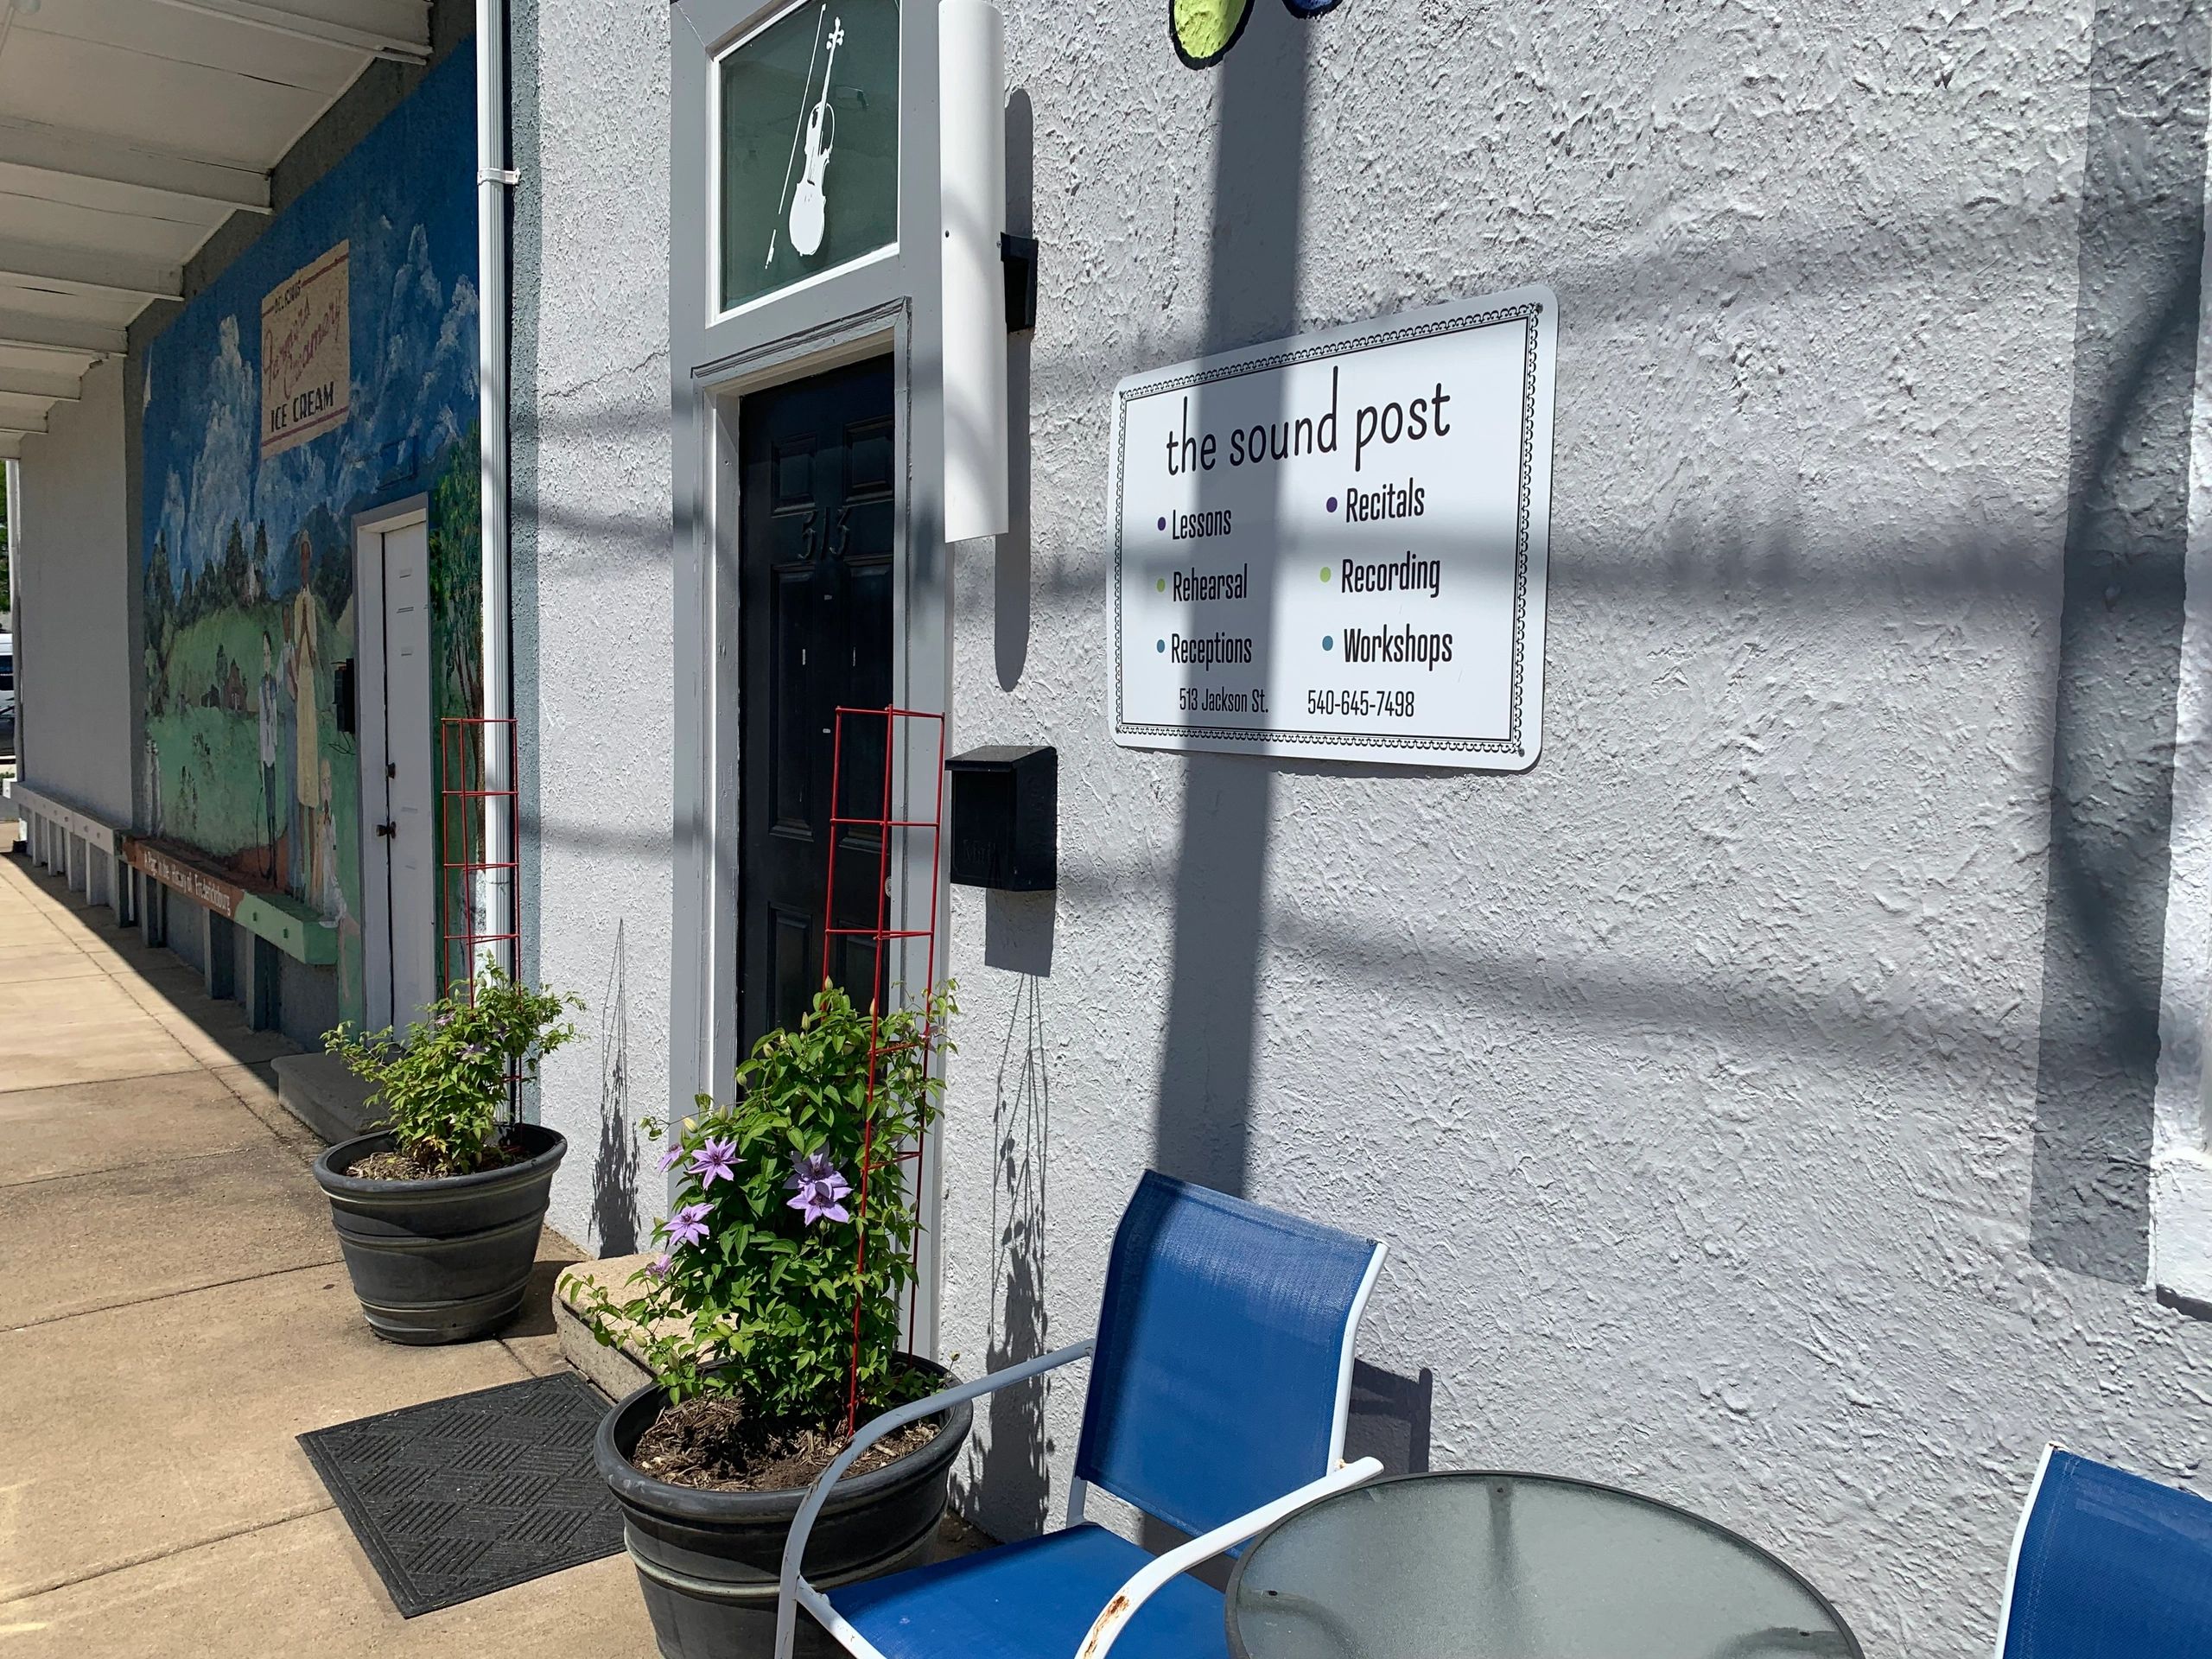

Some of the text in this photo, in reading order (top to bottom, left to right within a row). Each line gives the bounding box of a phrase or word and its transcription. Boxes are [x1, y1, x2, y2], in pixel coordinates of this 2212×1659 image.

[270, 380, 334, 433] ICE CREAM
[1166, 365, 1451, 476] the sound post
[1345, 477, 1425, 523] Recitals
[1172, 509, 1232, 540] Lessons
[1173, 563, 1248, 602] Rehearsal
[1341, 550, 1441, 599] Recording
[1171, 632, 1253, 672] Receptions
[1344, 623, 1454, 672] Workshops
[1179, 686, 1269, 714] 513 Jackson St.
[1307, 690, 1416, 718] 540-645-7498
